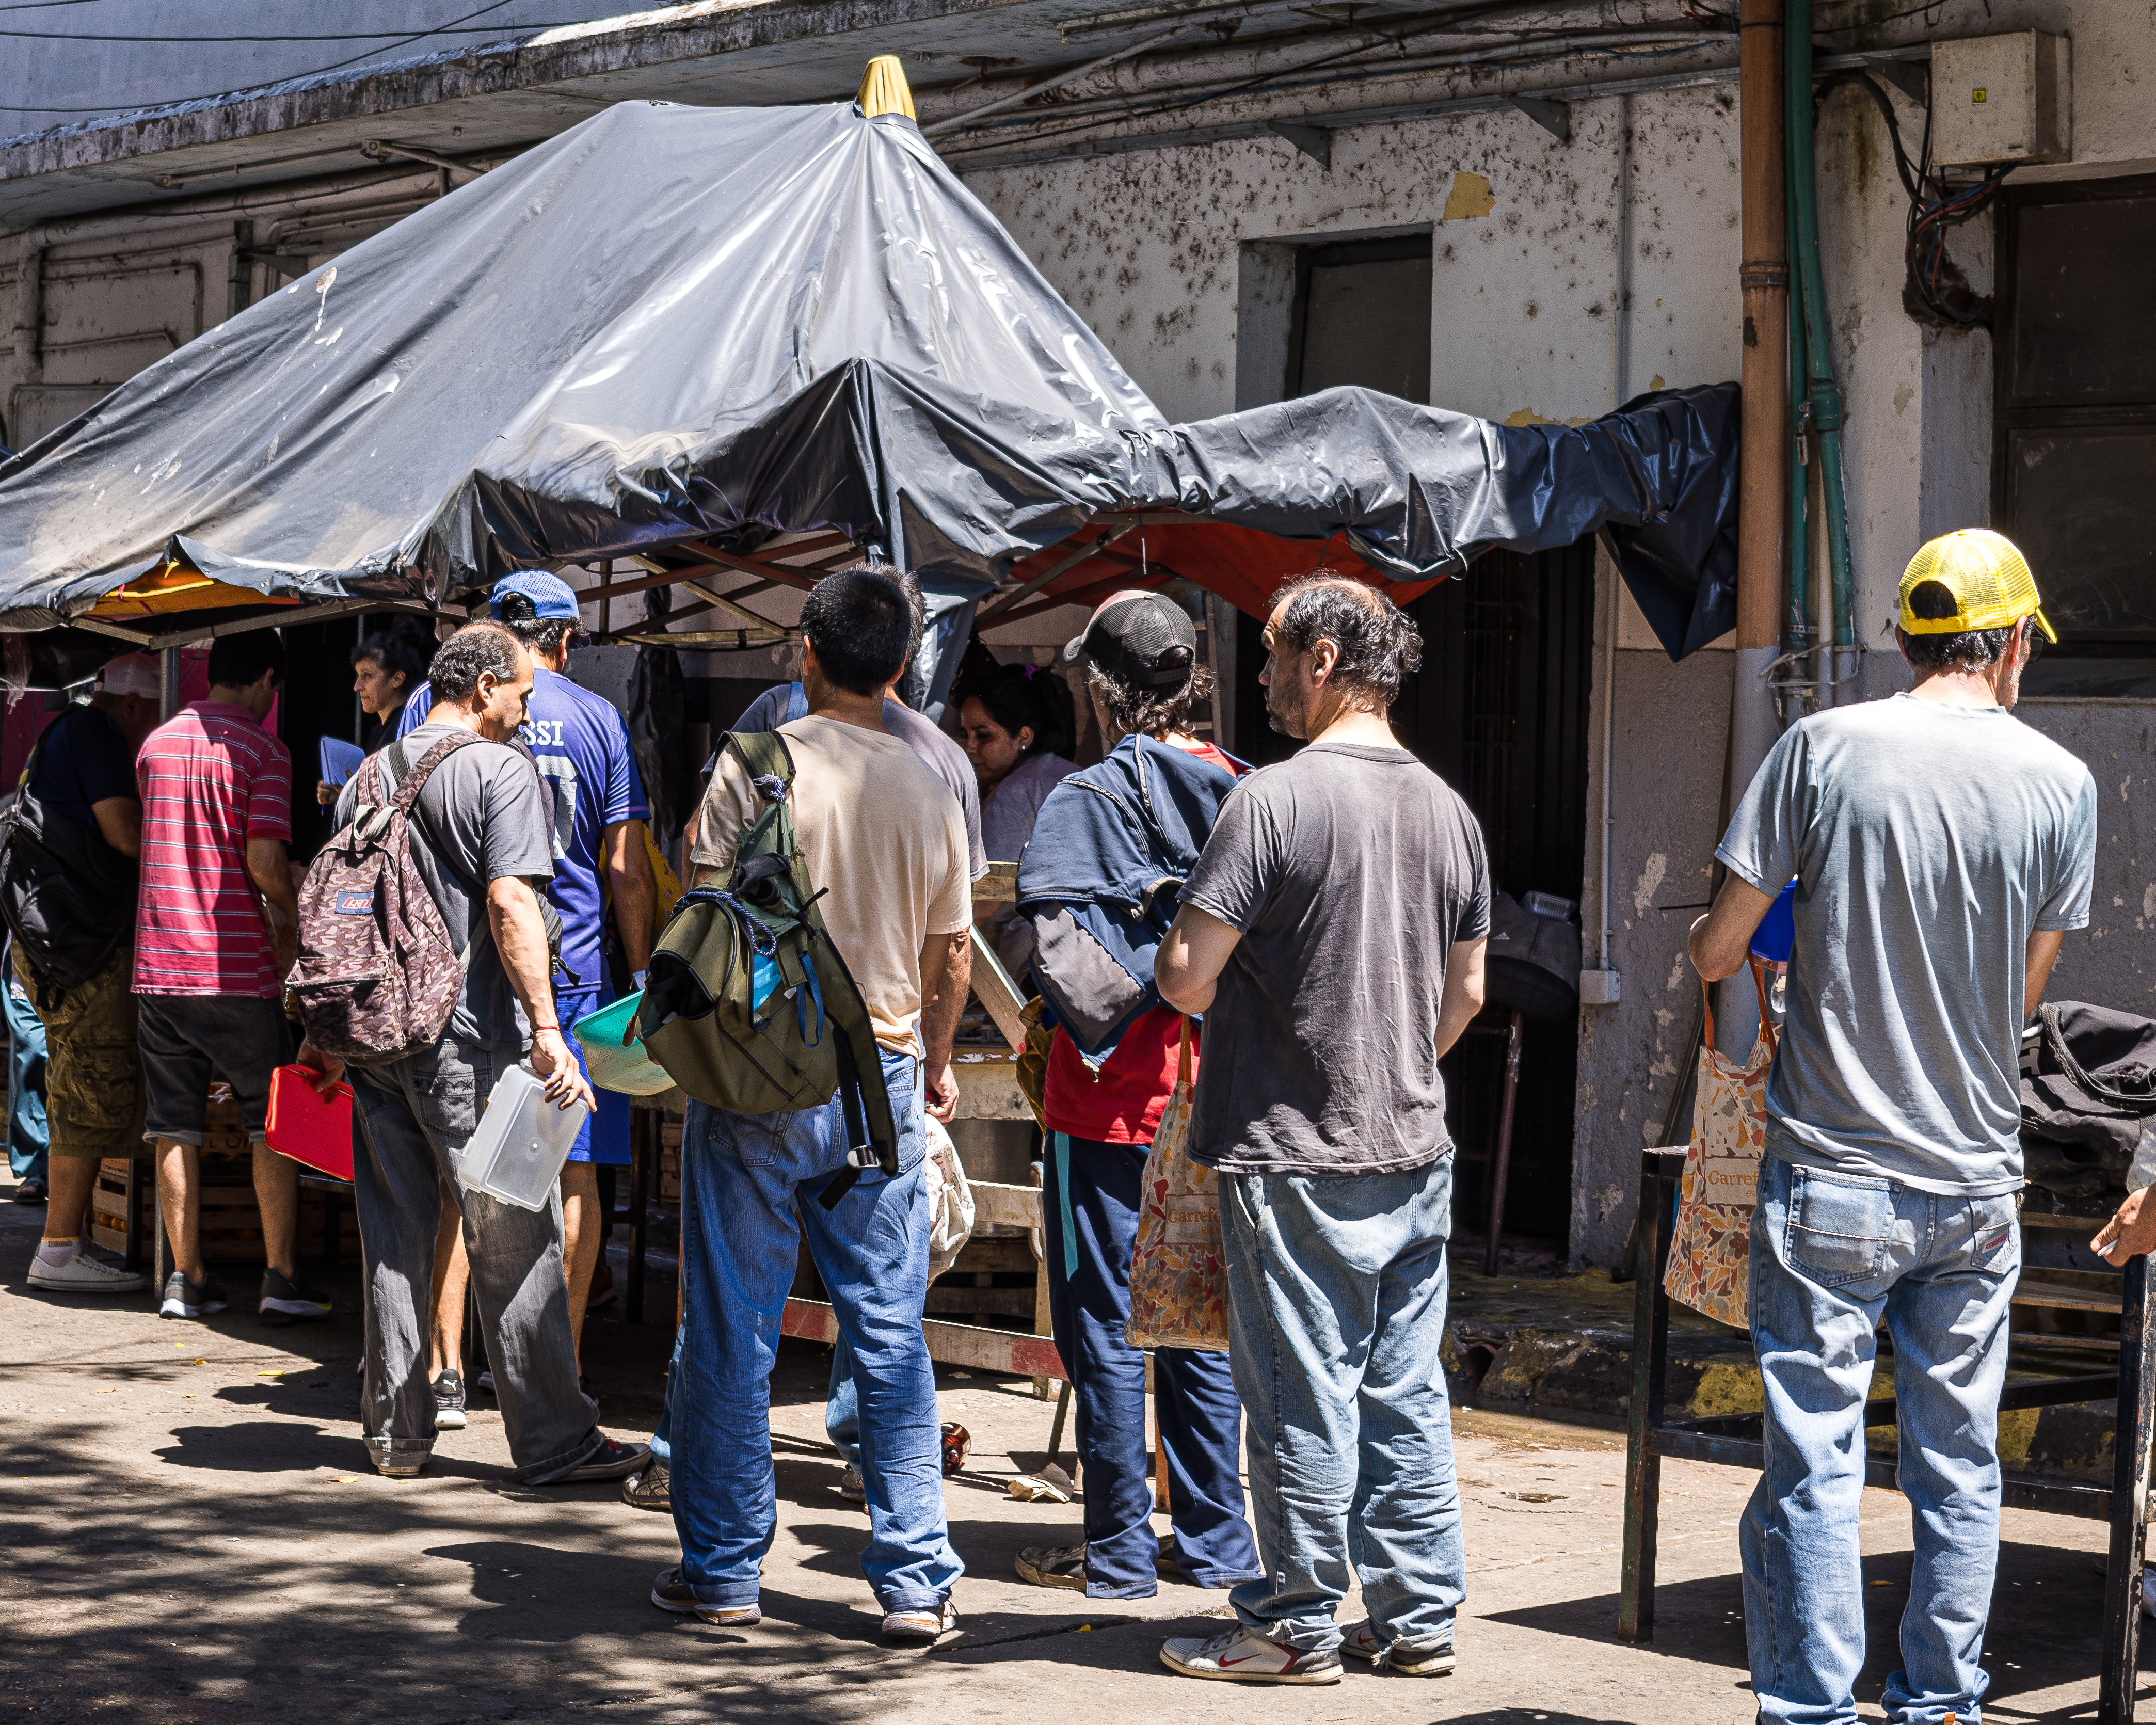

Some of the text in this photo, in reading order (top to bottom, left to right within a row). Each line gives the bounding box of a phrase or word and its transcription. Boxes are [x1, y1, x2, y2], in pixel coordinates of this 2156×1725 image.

[523, 721, 564, 746] SSI
[1708, 1170, 1759, 1186] Carref
[1168, 1207, 1221, 1224] Carrefo
